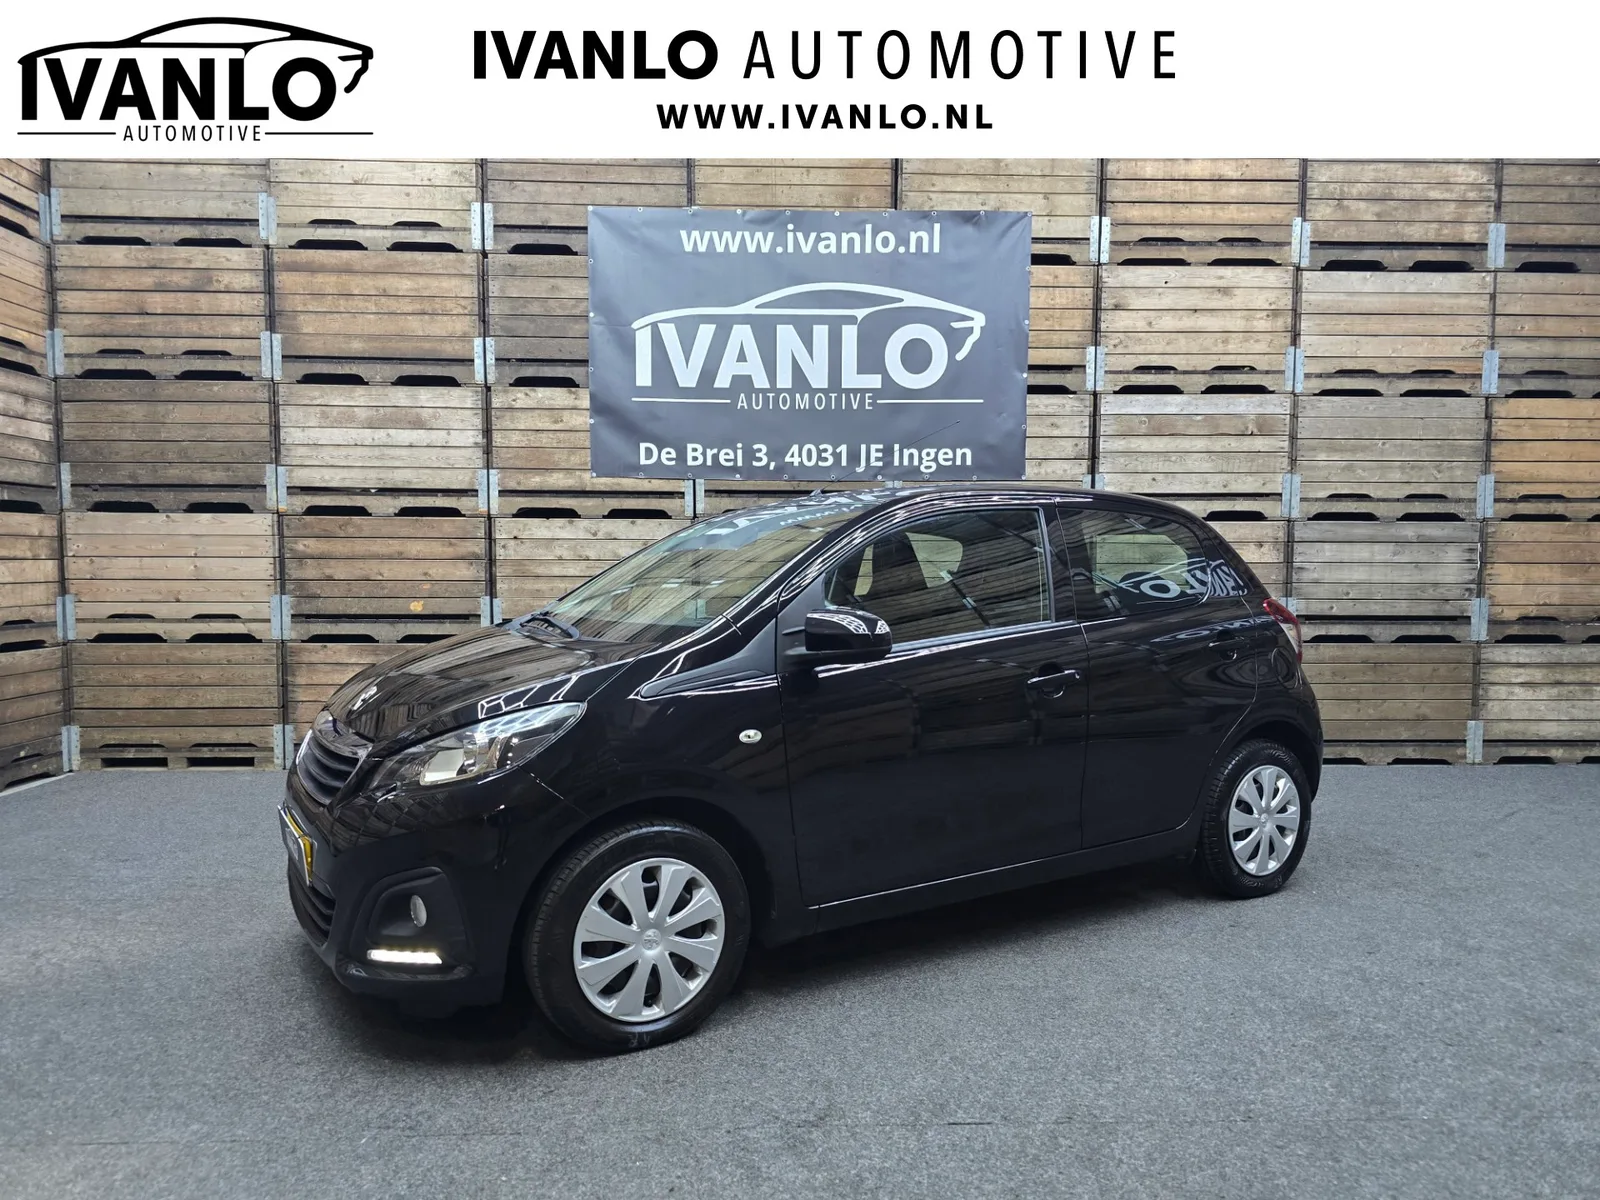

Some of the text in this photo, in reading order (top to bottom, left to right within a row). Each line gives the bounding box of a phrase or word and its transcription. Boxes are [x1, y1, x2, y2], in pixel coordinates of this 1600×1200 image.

[679, 223, 941, 254] www.ivanlo.nl
[635, 323, 949, 390] IVANLO
[737, 392, 873, 411] AUTOMOTIVE
[639, 443, 972, 473] De Brei 3, 4031 JE Ingen
